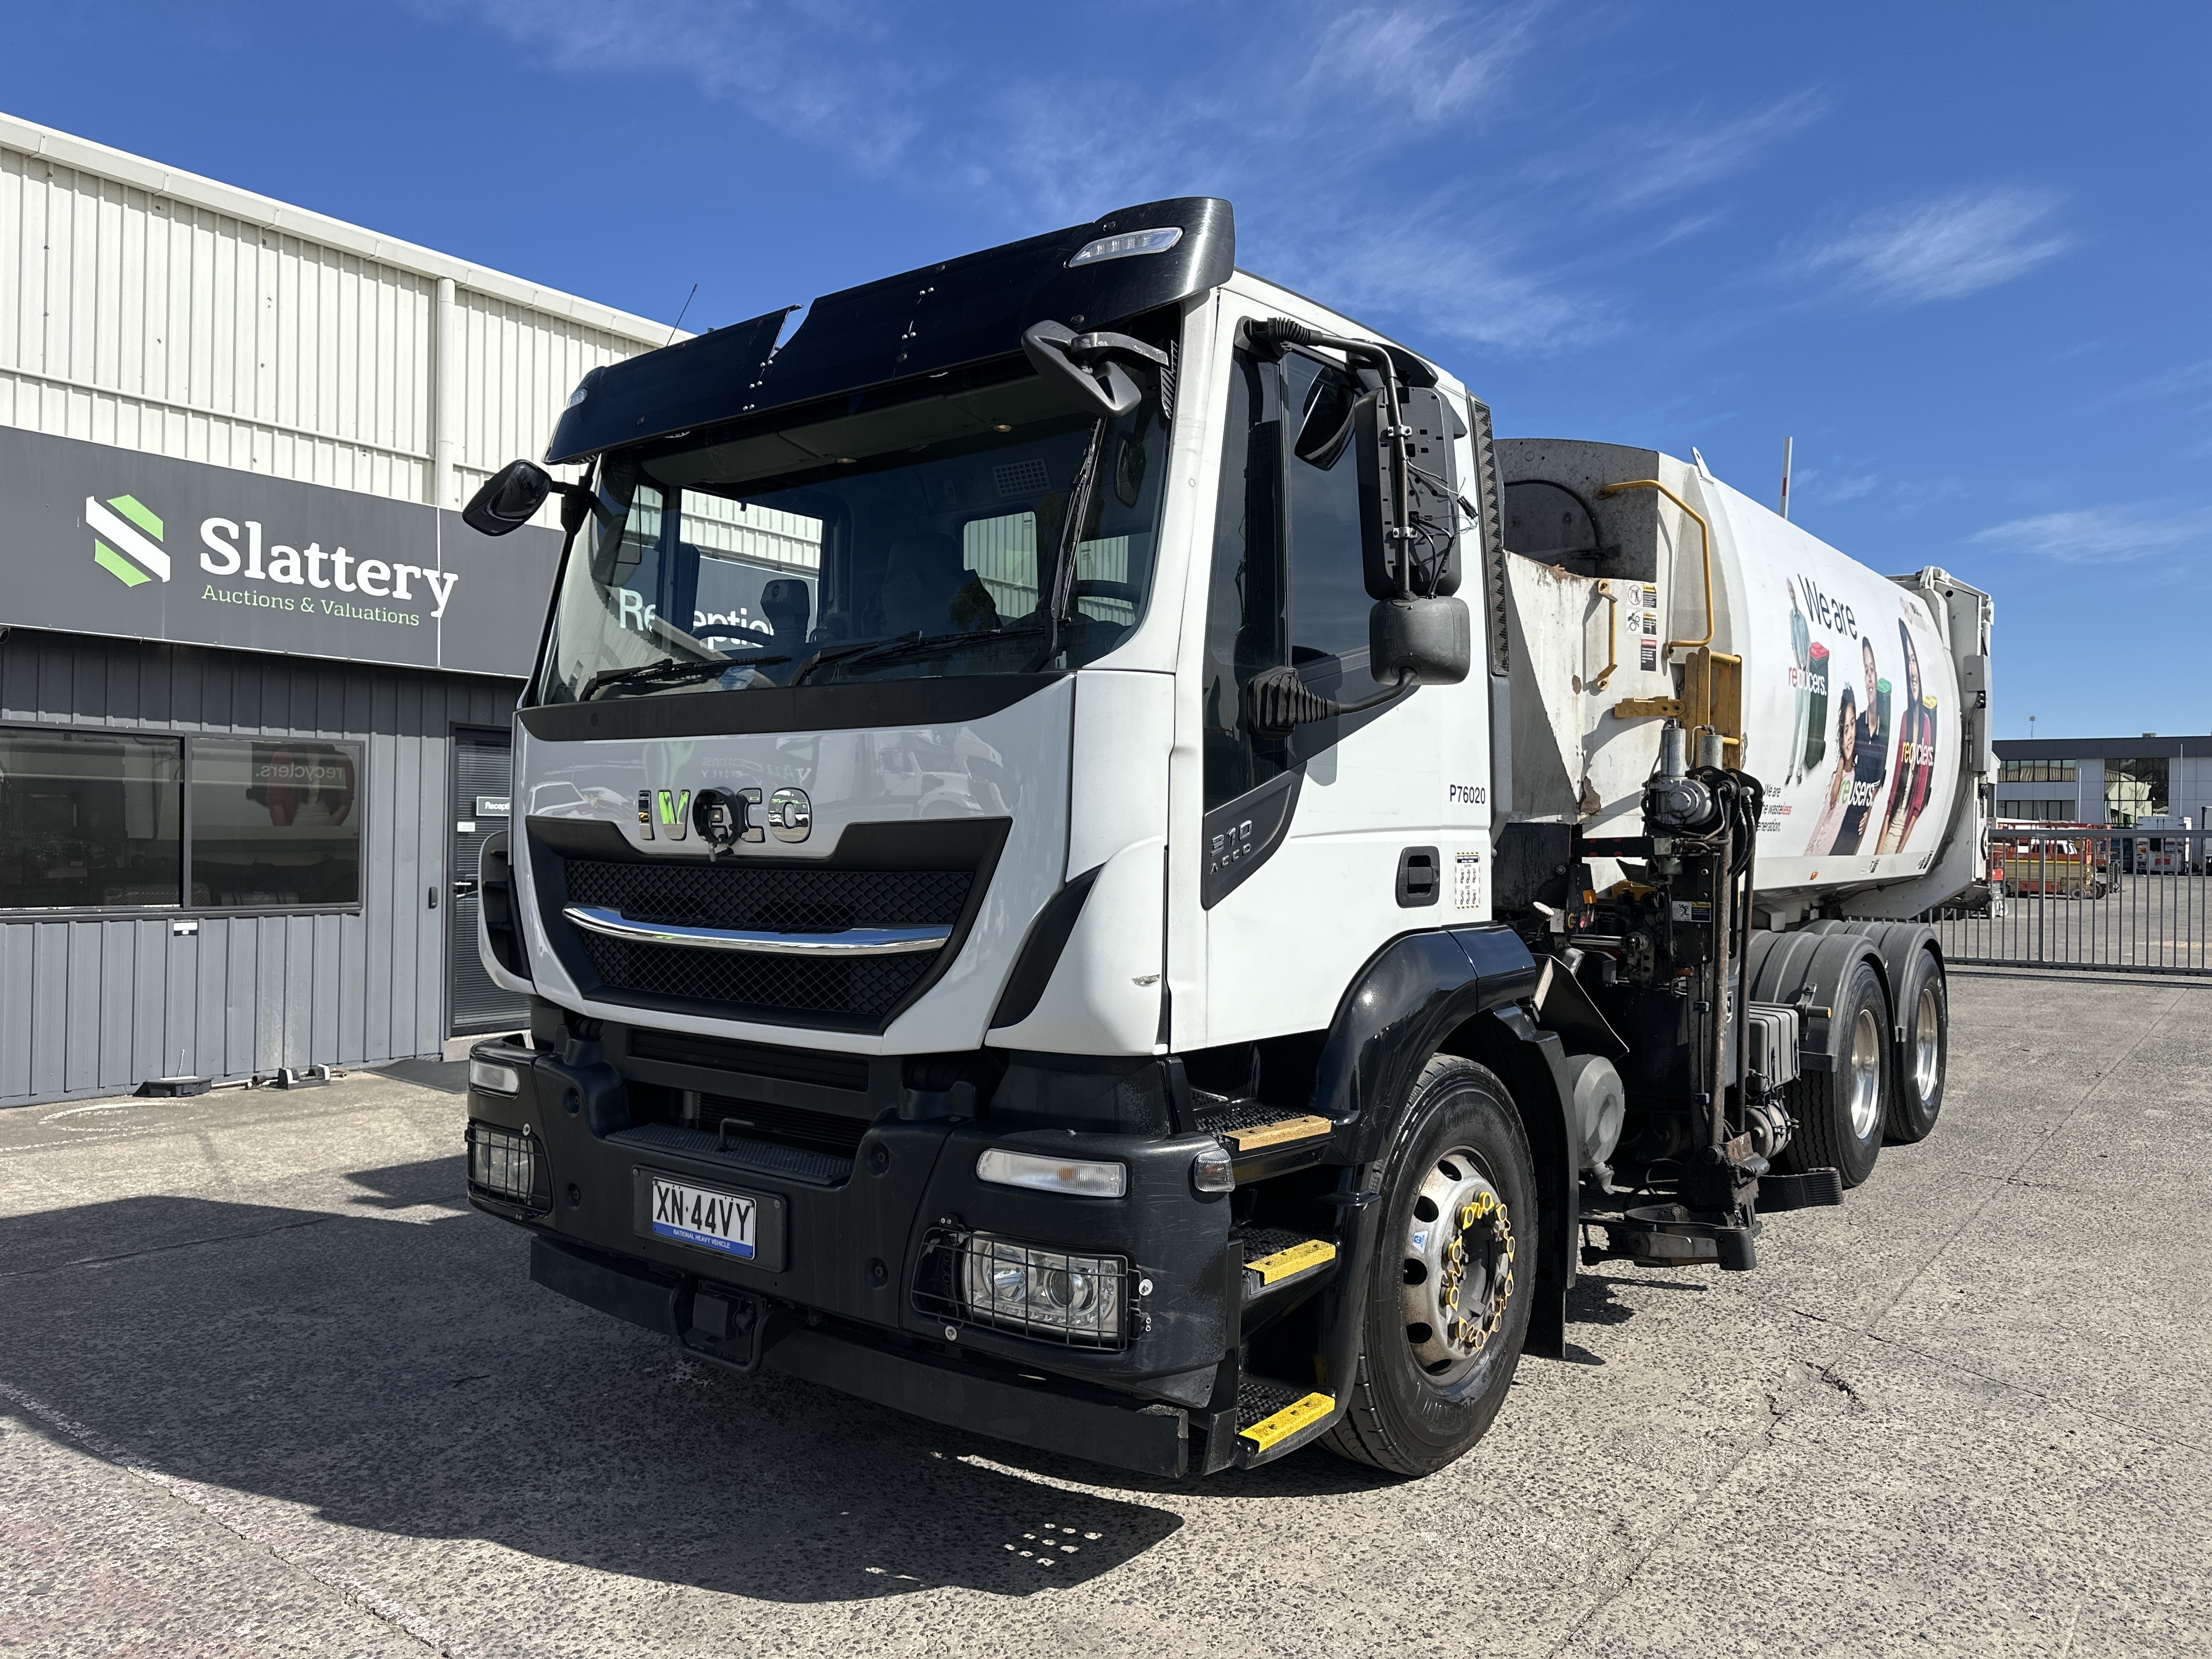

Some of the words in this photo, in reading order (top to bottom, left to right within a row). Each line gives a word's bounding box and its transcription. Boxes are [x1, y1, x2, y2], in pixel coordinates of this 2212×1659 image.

[200, 517, 459, 618] Slattery
[201, 584, 294, 611] Auctions
[300, 597, 315, 613] &
[320, 599, 420, 626] Valuations
[1797, 574, 1831, 629] We
[1831, 598, 1857, 640] are
[1788, 663, 1827, 696] reducers.
[1901, 737, 1934, 770] recyclers.
[485, 801, 510, 811] Recepti
[1450, 784, 1486, 805] P76020
[1765, 783, 1773, 797] We
[1772, 787, 1781, 798] are
[1837, 780, 1875, 807] reusers.
[1210, 820, 1252, 857] 310
[1757, 819, 1781, 832] eneration.
[1208, 843, 1251, 876] ACCO
[673, 1229, 695, 1240] NATIONAL
[695, 1234, 712, 1243] HEAVY
[711, 1238, 730, 1249] VEHICLE
